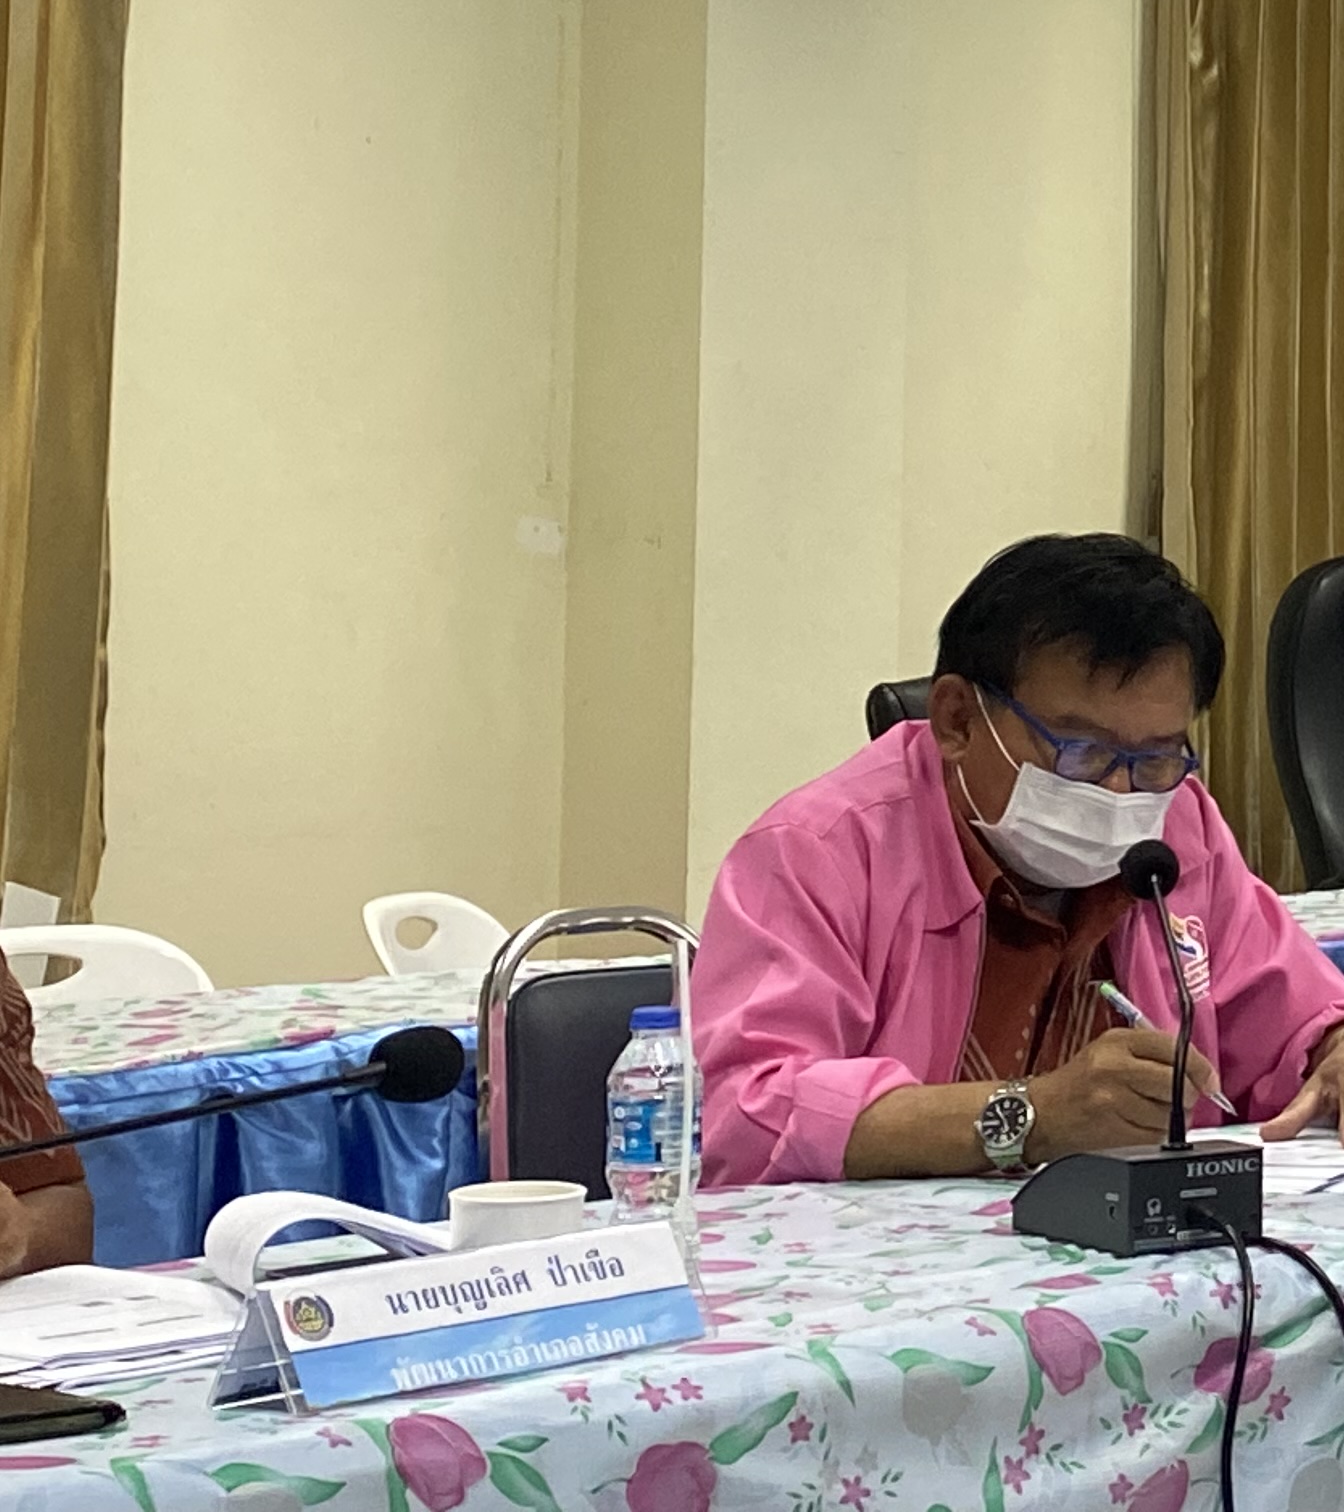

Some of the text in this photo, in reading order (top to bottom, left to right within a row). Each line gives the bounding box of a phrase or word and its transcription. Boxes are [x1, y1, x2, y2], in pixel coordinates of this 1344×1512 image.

[1186, 1157, 1260, 1178] HONIC
[385, 1265, 532, 1314] นายบุญเลิศ
[390, 1321, 647, 1389] พัฒนาการอำเภอสังคม
